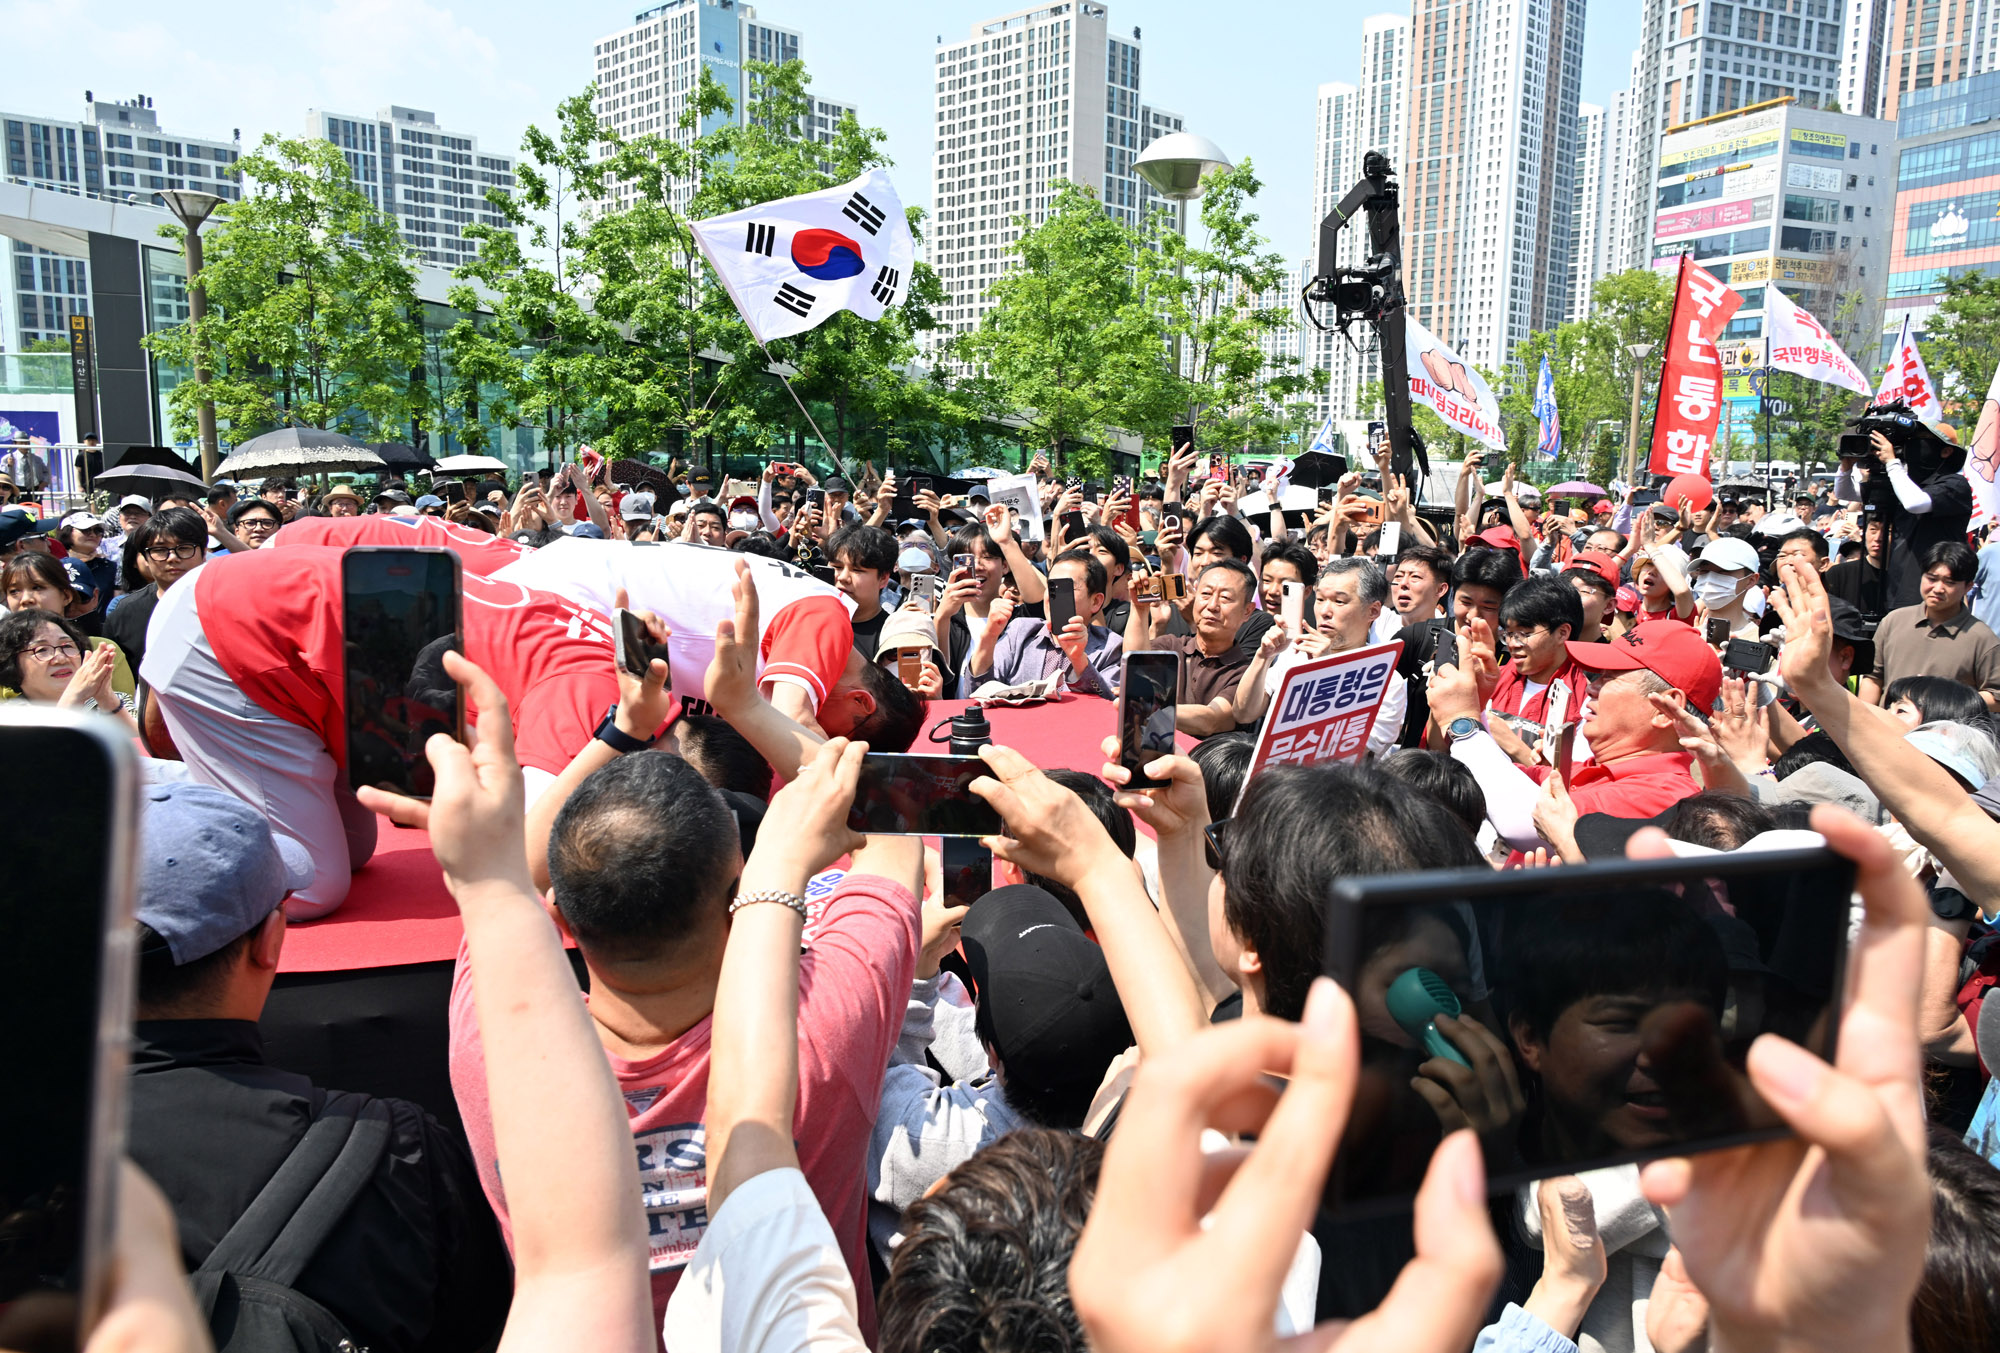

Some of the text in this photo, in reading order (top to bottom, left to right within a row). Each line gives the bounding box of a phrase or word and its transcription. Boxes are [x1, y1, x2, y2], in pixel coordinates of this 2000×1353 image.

[75, 333, 83, 343] 2
[76, 358, 86, 377] 다산
[1280, 662, 1389, 724] 대통령은
